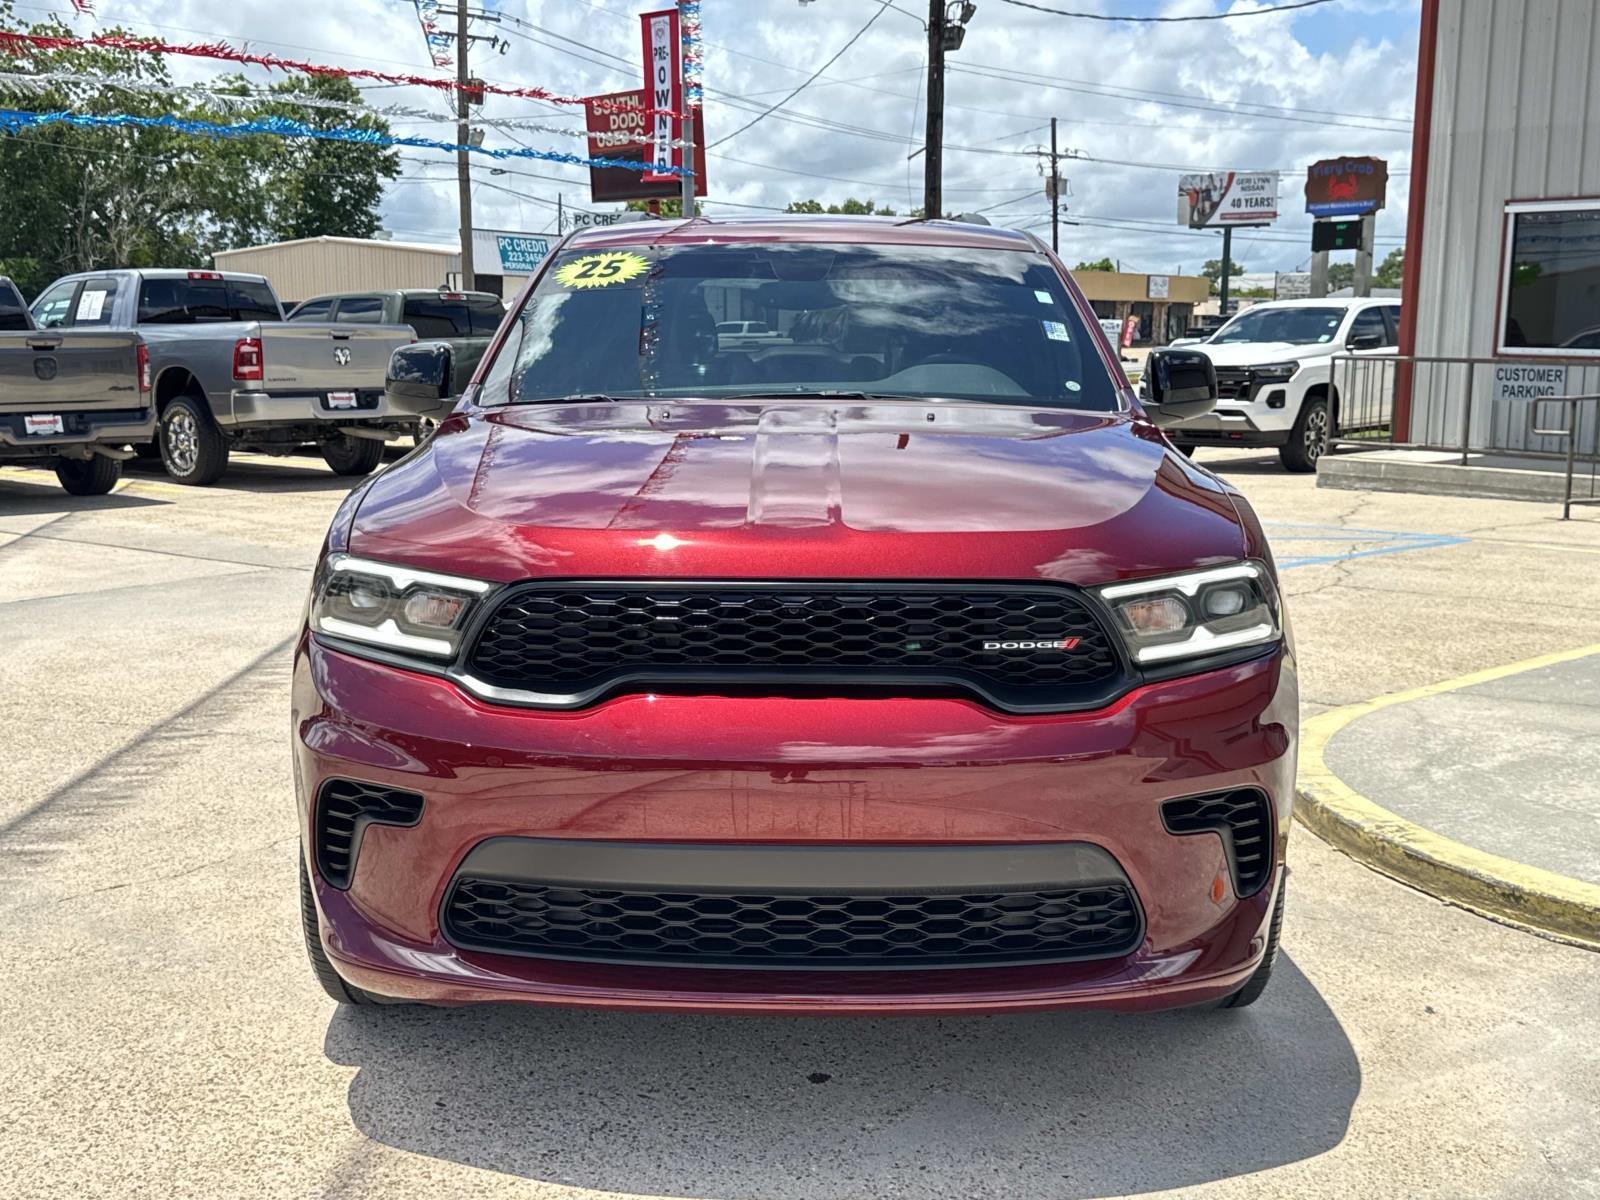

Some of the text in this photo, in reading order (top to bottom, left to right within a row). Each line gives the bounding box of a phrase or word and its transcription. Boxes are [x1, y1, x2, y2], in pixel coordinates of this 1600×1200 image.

[1253, 177, 1271, 185] LYNN
[1240, 184, 1265, 192] NISSAN
[1231, 197, 1274, 208] 40 YEARS!
[574, 214, 590, 226] PC
[498, 237, 547, 253] PC CREDIT
[574, 259, 626, 279] 25
[1496, 367, 1563, 383] CUSTOMER
[1502, 384, 1555, 399] PARKING
[983, 641, 1068, 650] DODGE
